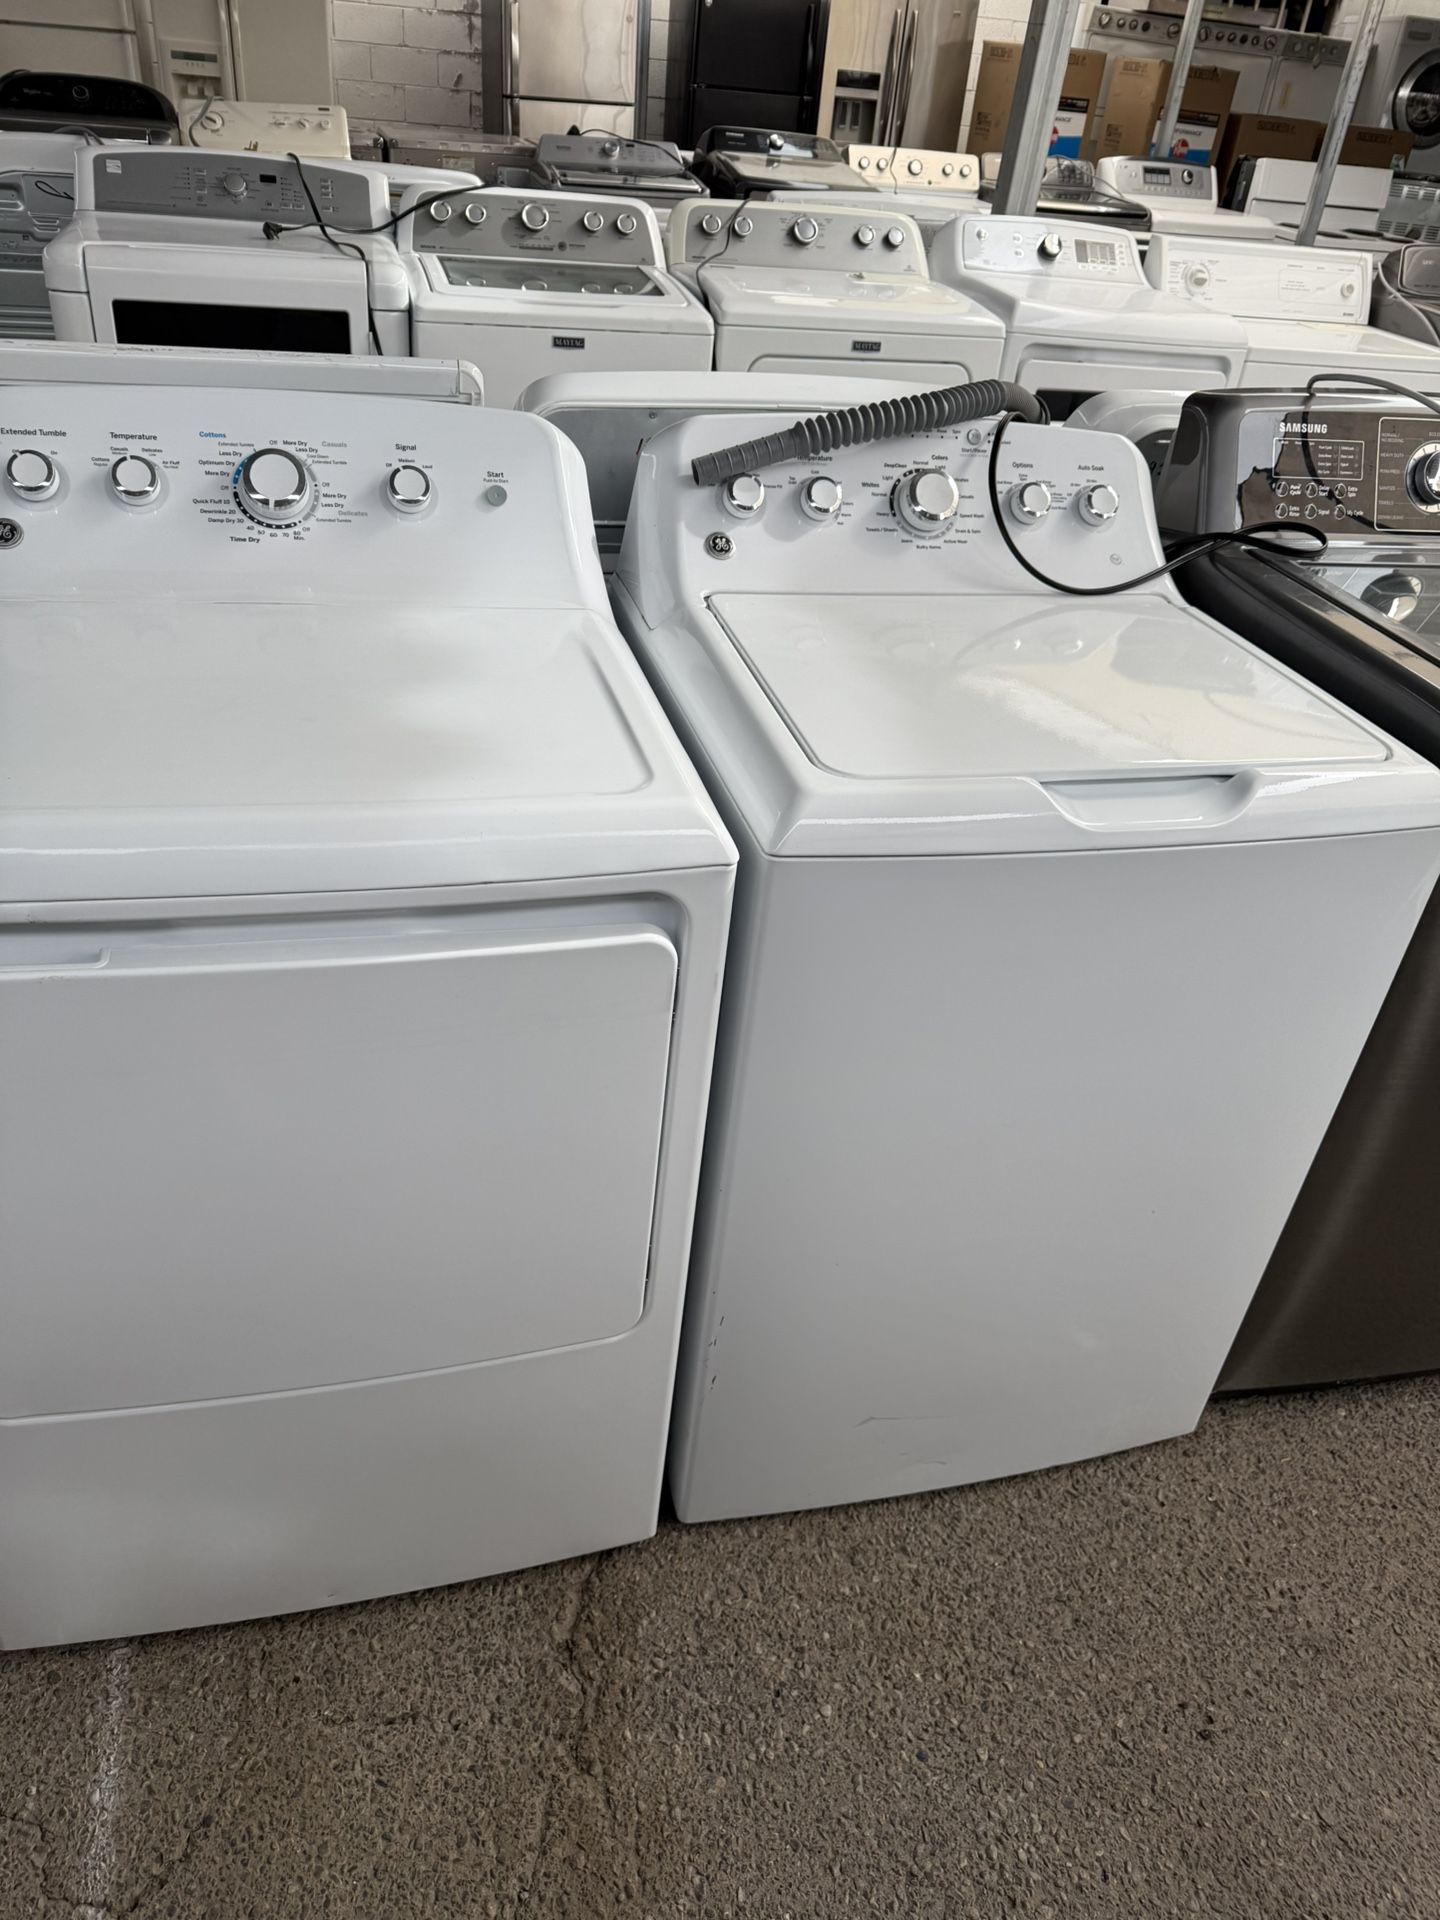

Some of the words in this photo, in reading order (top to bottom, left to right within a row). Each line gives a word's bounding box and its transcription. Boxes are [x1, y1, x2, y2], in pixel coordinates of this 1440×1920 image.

[555, 338, 585, 347] MAYTAG
[0, 428, 37, 436] Extended
[39, 429, 67, 437] Tumble
[1279, 422, 1328, 434] SAMSUNG
[110, 432, 158, 441] Temperature
[395, 443, 417, 451] Signal
